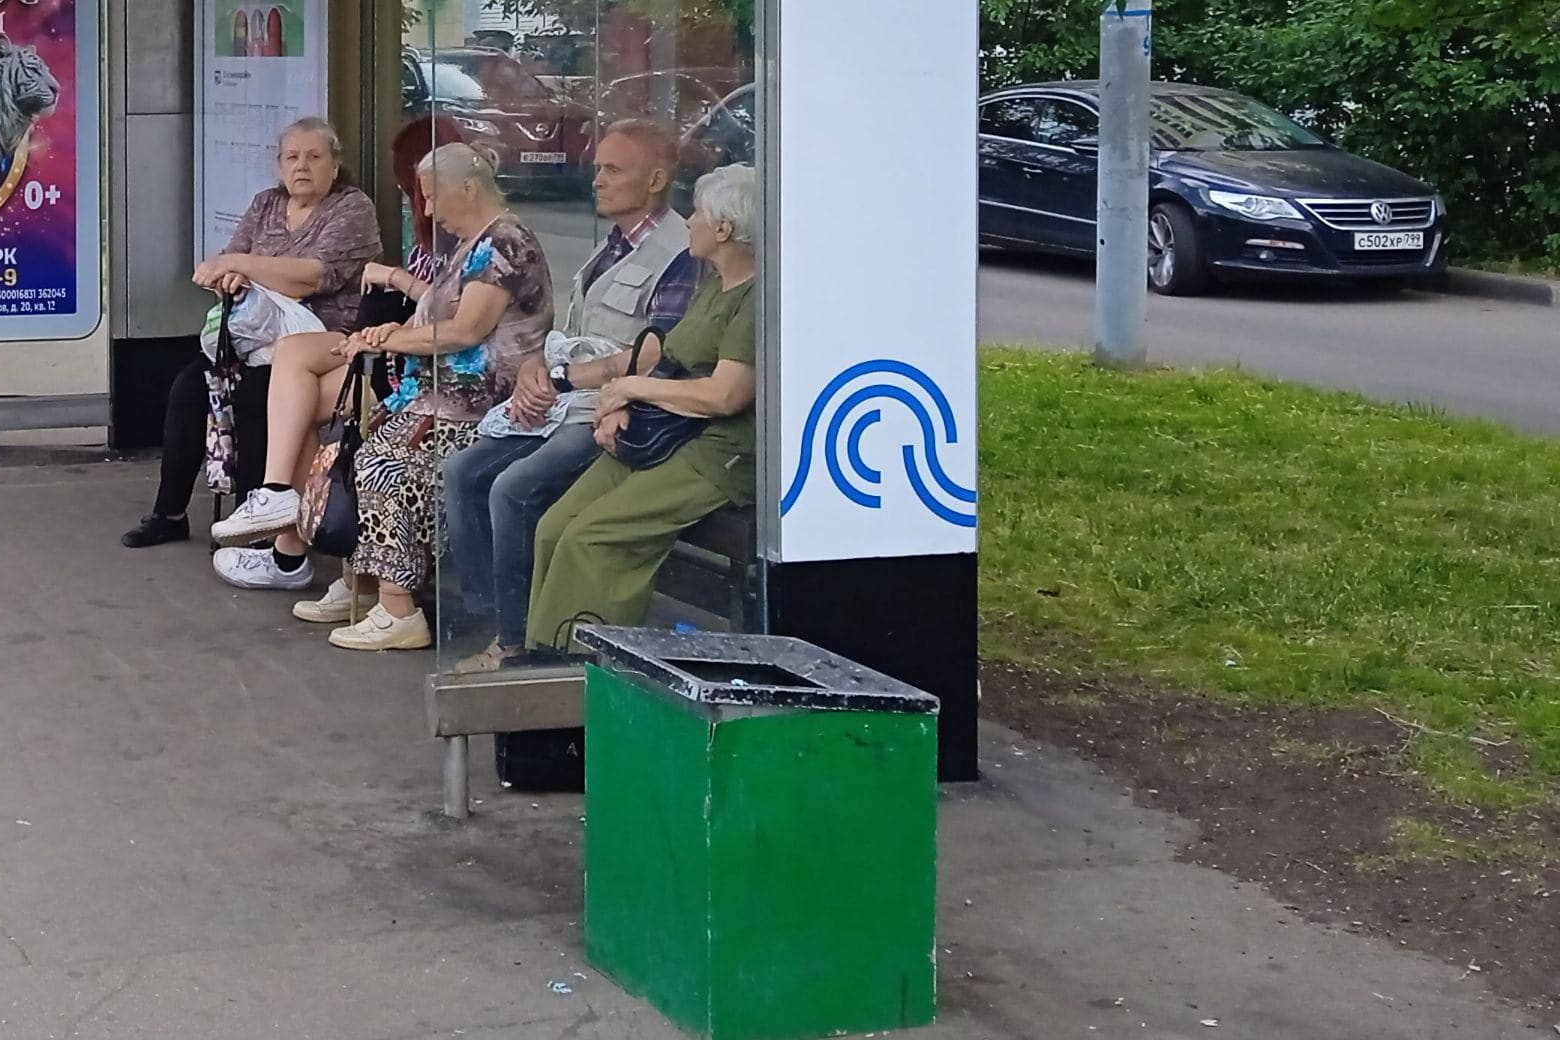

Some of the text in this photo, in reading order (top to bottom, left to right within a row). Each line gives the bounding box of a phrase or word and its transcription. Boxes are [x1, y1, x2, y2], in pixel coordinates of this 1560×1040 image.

[24, 180, 61, 210] 0+
[38, 288, 66, 300] 362045
[47, 301, 56, 311] 12
